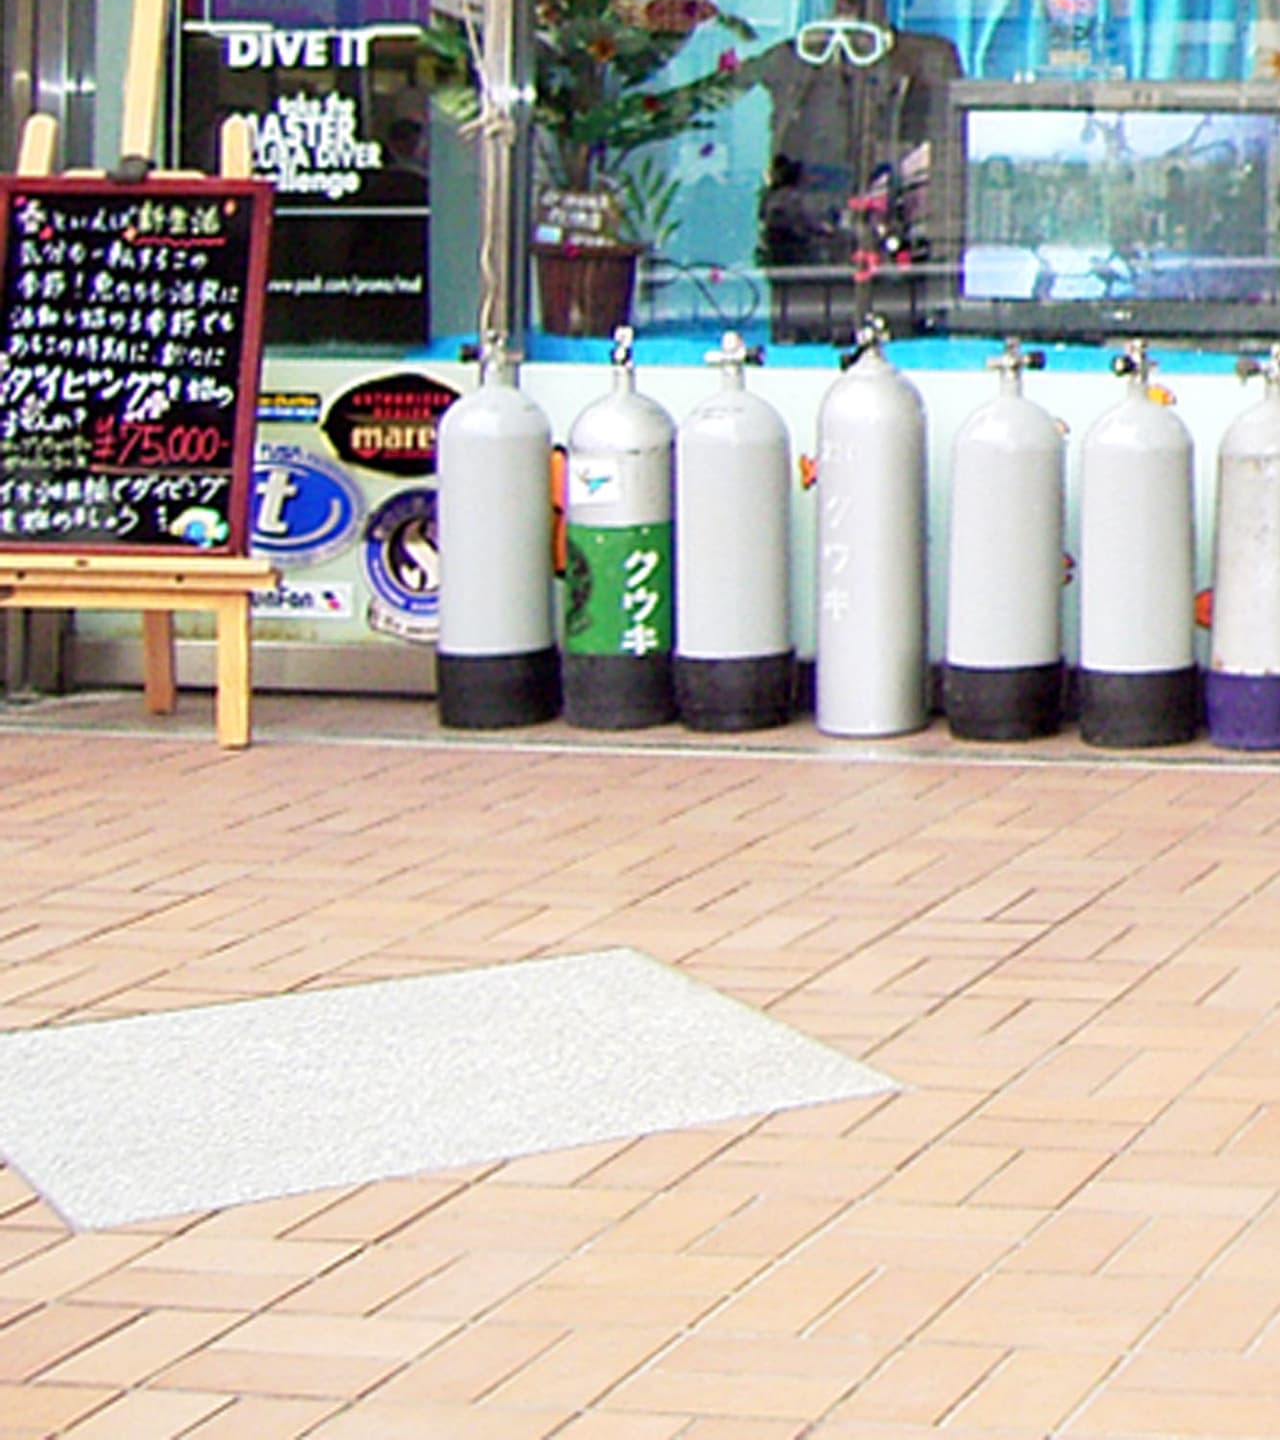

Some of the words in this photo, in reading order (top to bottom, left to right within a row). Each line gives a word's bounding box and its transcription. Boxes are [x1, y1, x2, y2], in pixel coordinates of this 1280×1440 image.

[228, 31, 328, 67] DIVE
[339, 31, 373, 67] IT
[621, 549, 660, 656] クウキ
